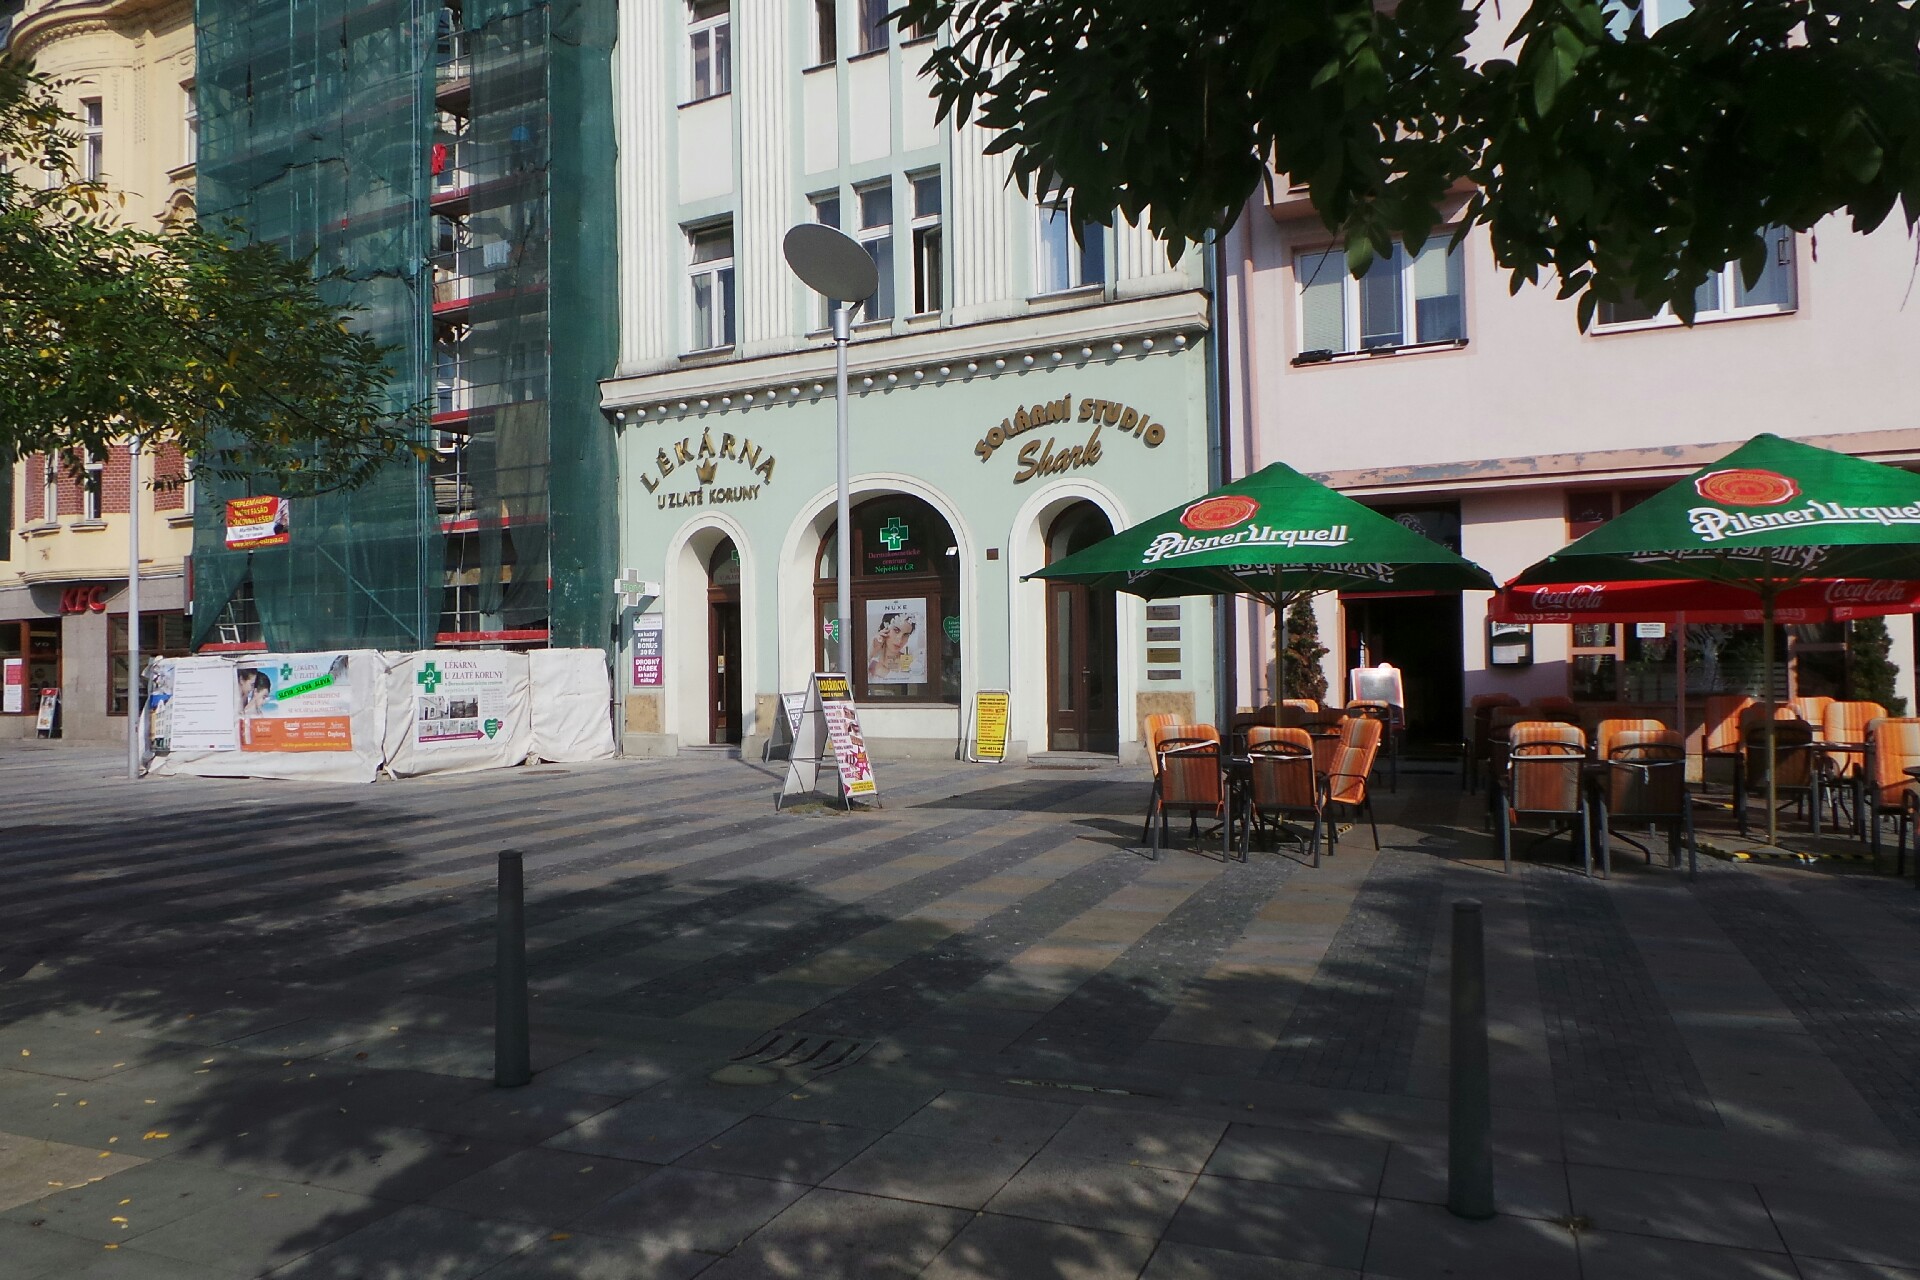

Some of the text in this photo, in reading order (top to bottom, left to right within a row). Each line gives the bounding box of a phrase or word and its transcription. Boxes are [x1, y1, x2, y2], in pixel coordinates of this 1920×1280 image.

[974, 393, 1166, 464] SOLÁRNÍ STUDIO
[640, 426, 776, 495] LÉKÁRNA
[1013, 424, 1103, 485] Shark
[657, 484, 761, 510] U ZLATÉ KORUNY
[251, 506, 269, 515] FASÁD
[1687, 505, 1816, 542] Pilsner
[1142, 524, 1349, 564] Pilsner Urquell
[59, 585, 108, 614] KFC
[445, 660, 477, 669] LÉKÁRNA
[635, 657, 660, 666] DROBNÝ
[637, 664, 658, 672] DÁREK
[278, 690, 294, 698] SLEVA
[296, 684, 312, 694] SLEVA
[315, 678, 331, 687] SLEVA
[452, 671, 473, 679] ZLATÉ
[474, 671, 503, 679] KORUNY
